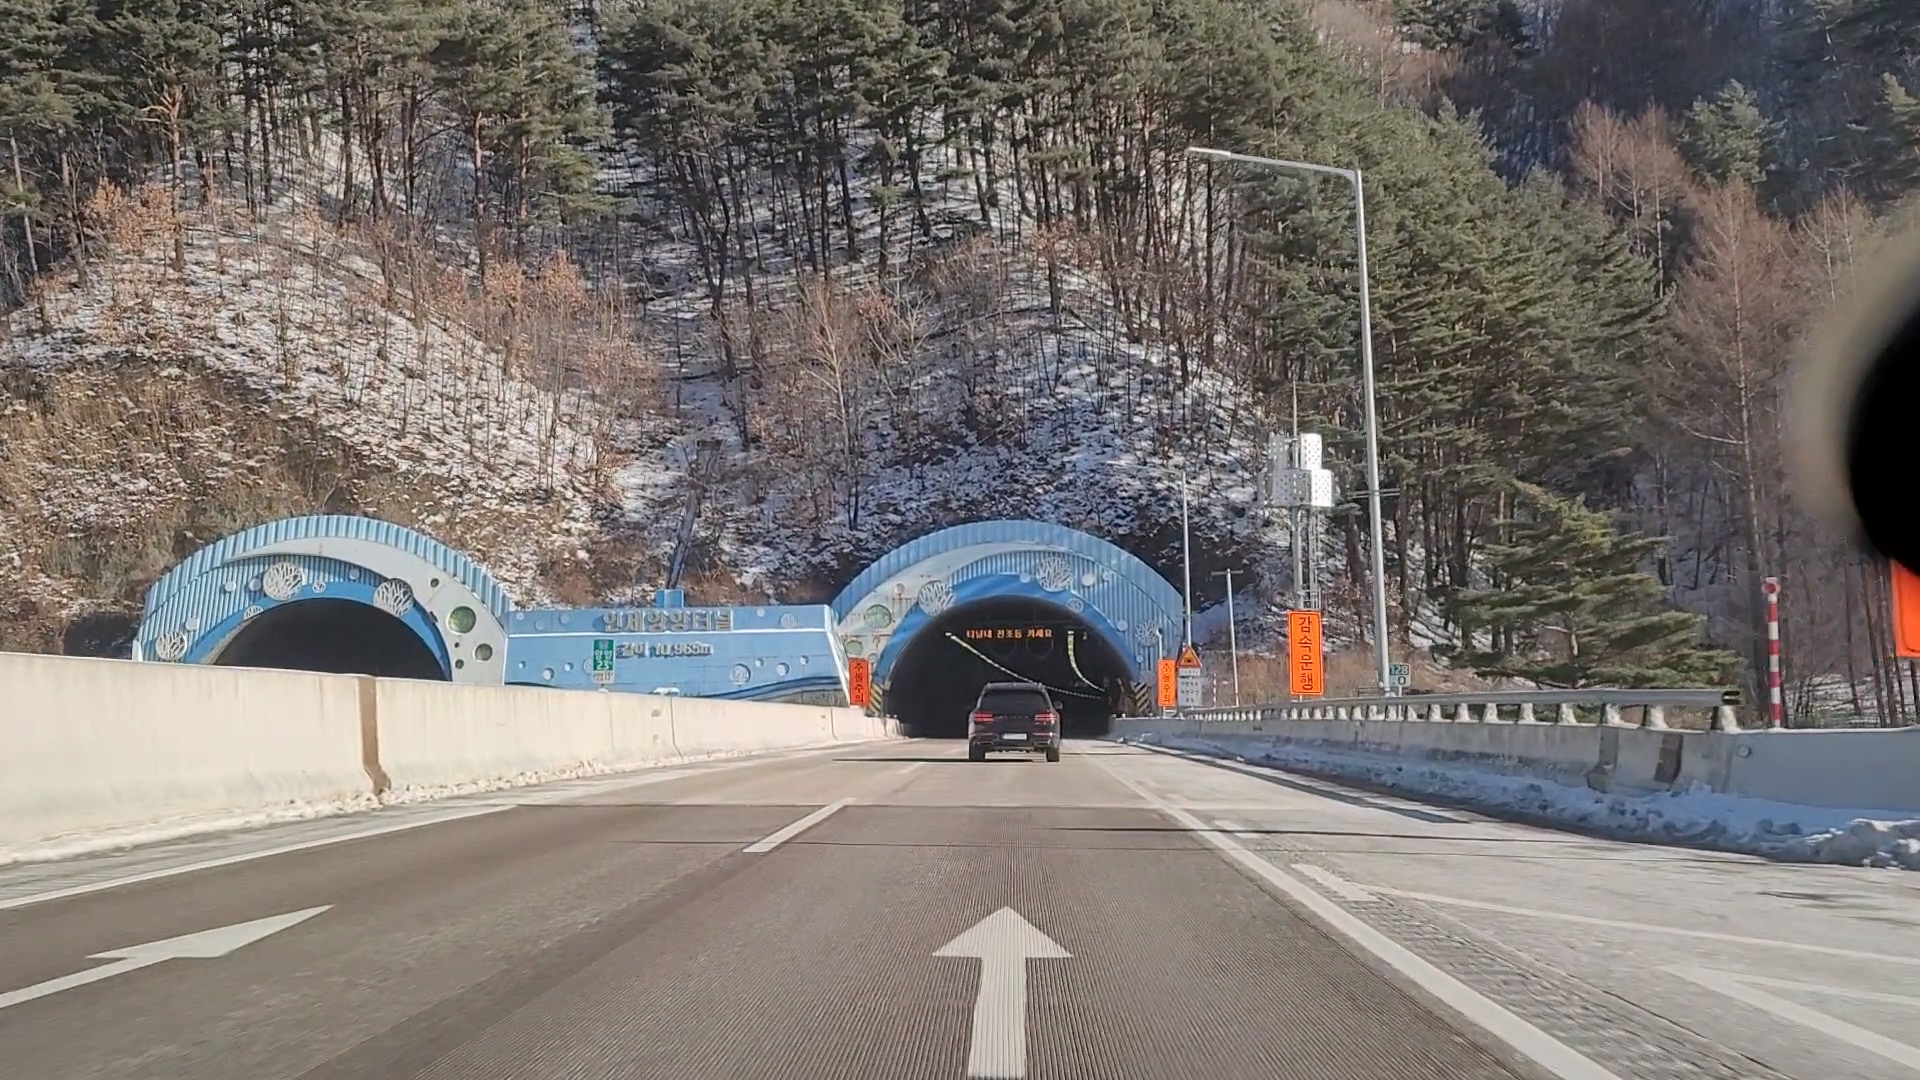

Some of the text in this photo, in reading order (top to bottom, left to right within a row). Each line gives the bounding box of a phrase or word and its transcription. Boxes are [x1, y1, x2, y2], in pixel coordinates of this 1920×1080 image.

[603, 609, 733, 632] 인제양양터널
[622, 642, 649, 656] 길이
[1298, 616, 1313, 691] 감속운행
[1390, 665, 1408, 675] 128
